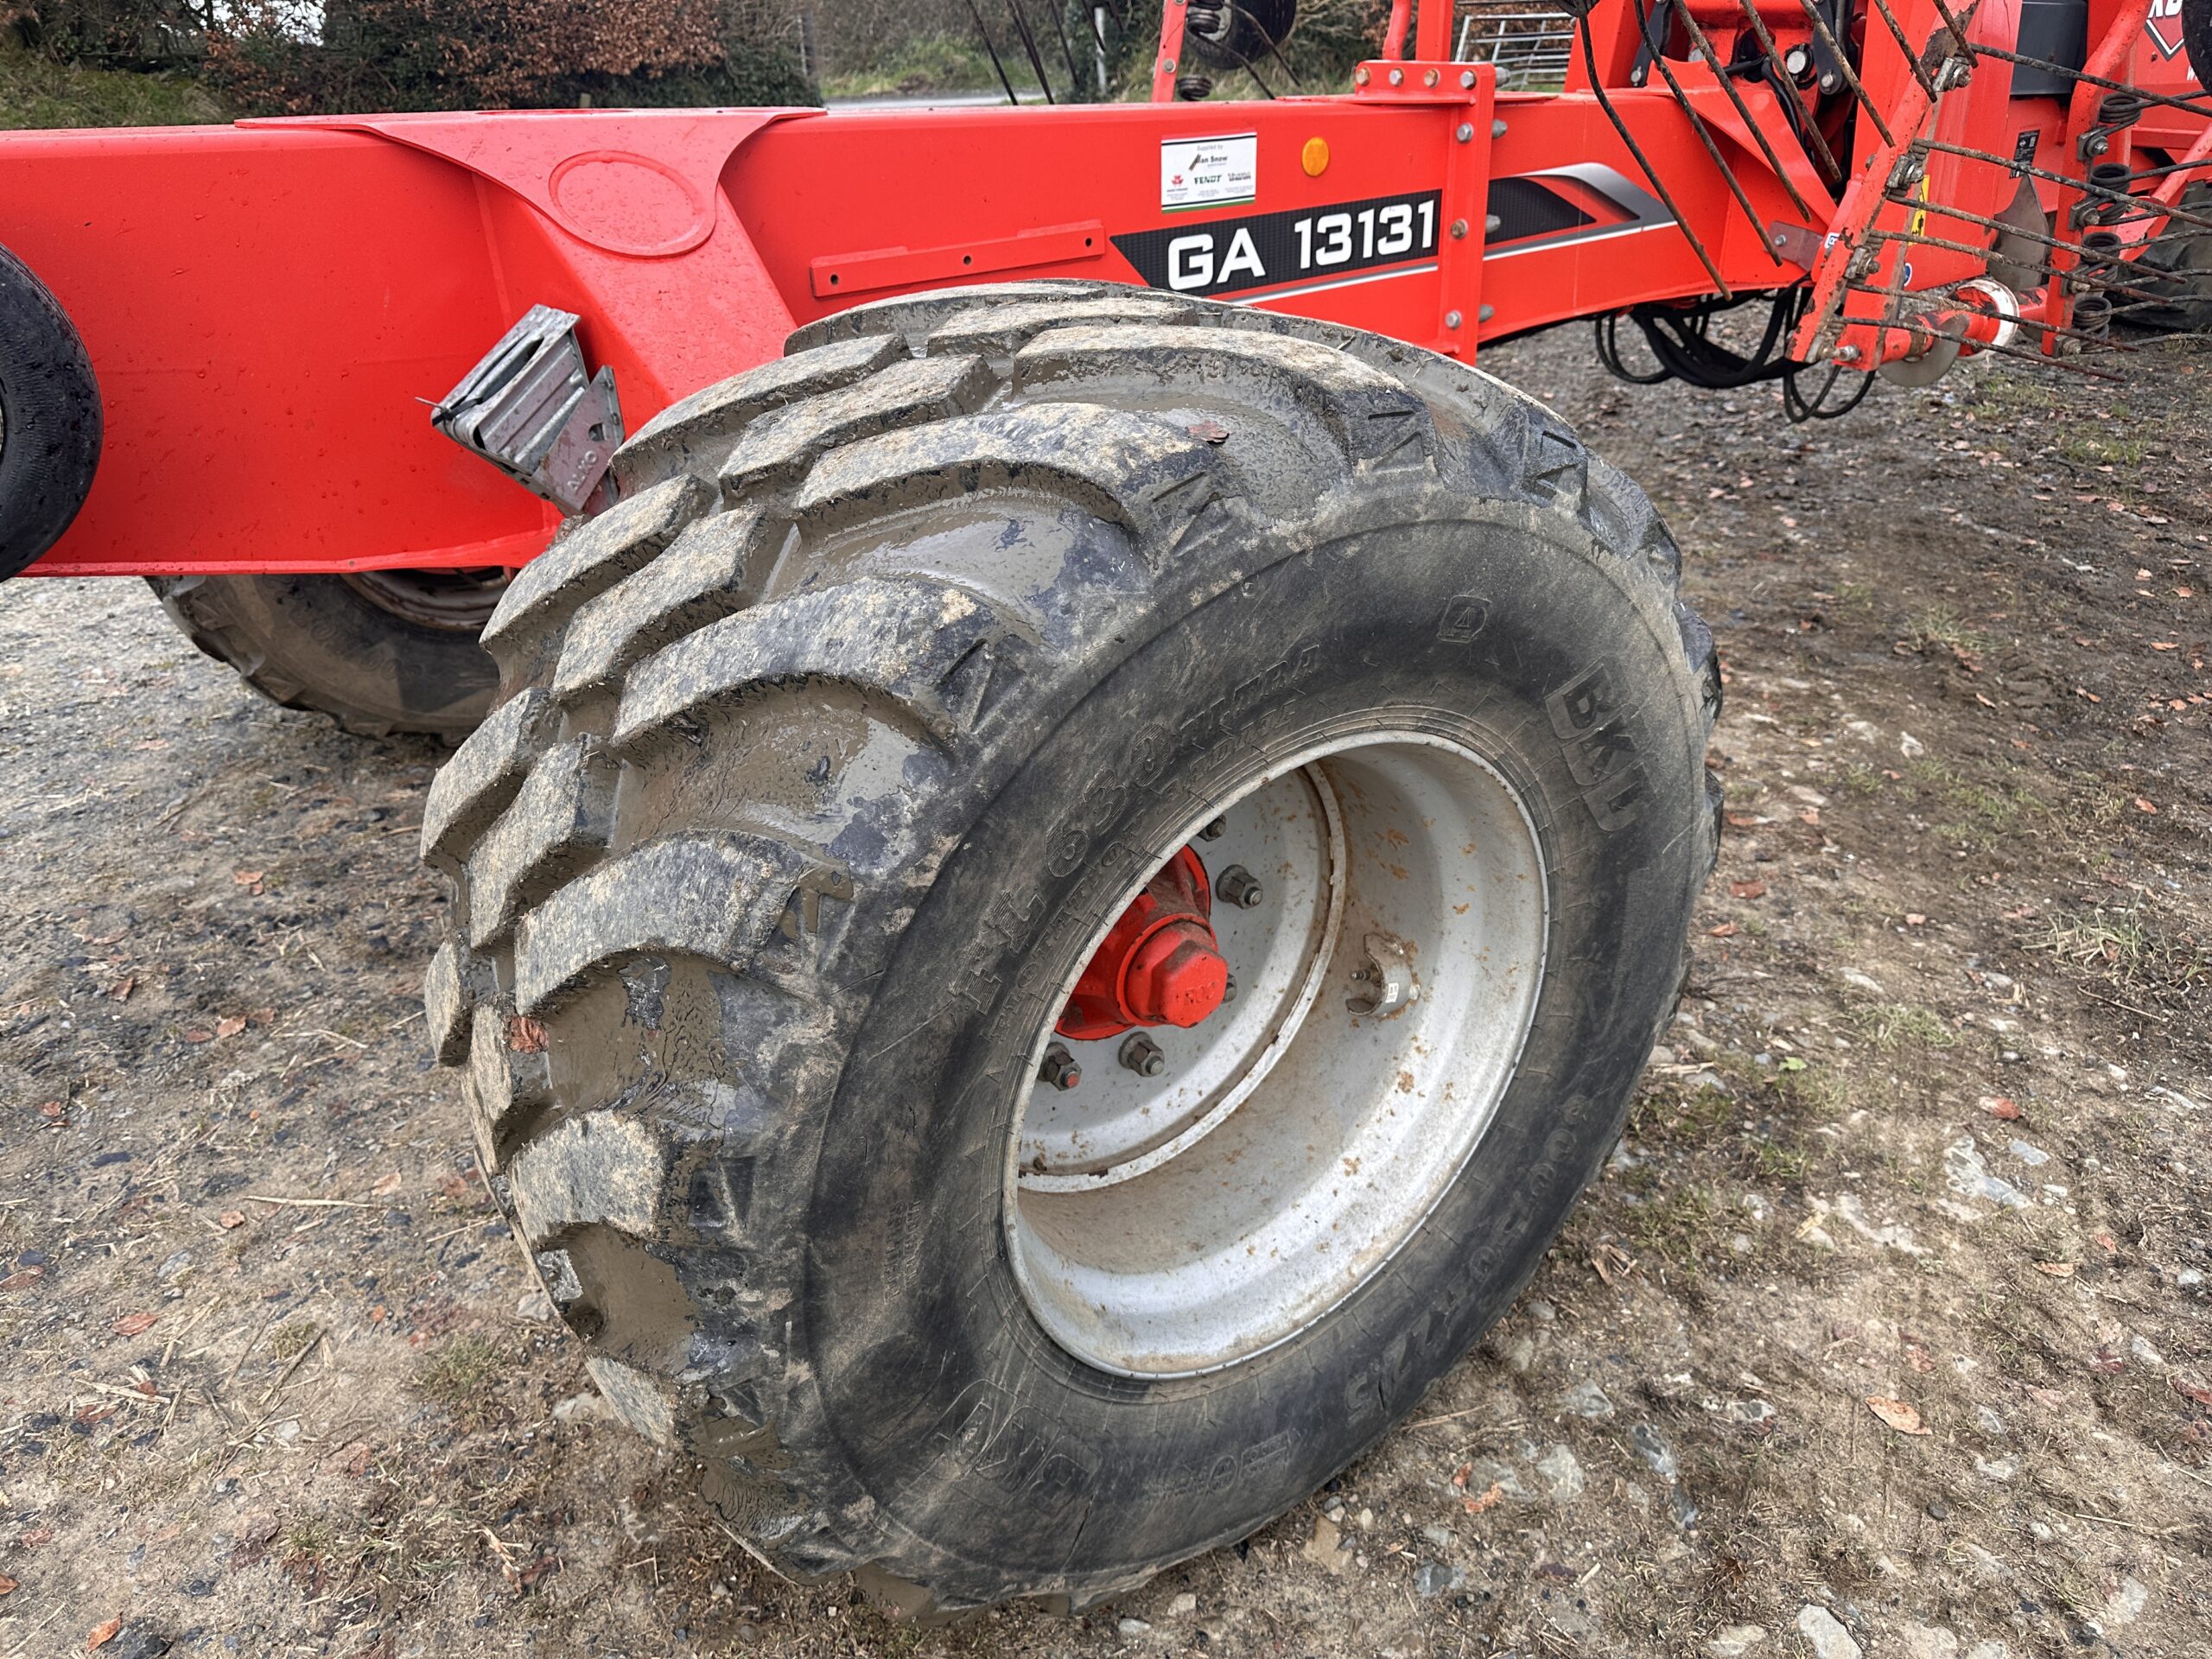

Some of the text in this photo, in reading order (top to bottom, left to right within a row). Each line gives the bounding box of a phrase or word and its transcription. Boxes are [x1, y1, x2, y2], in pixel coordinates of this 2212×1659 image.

[1194, 175, 1222, 185] FENDT
[1168, 200, 1434, 291] GA 13131
[1044, 721, 1172, 879] 630
[1546, 657, 1661, 830] BKT
